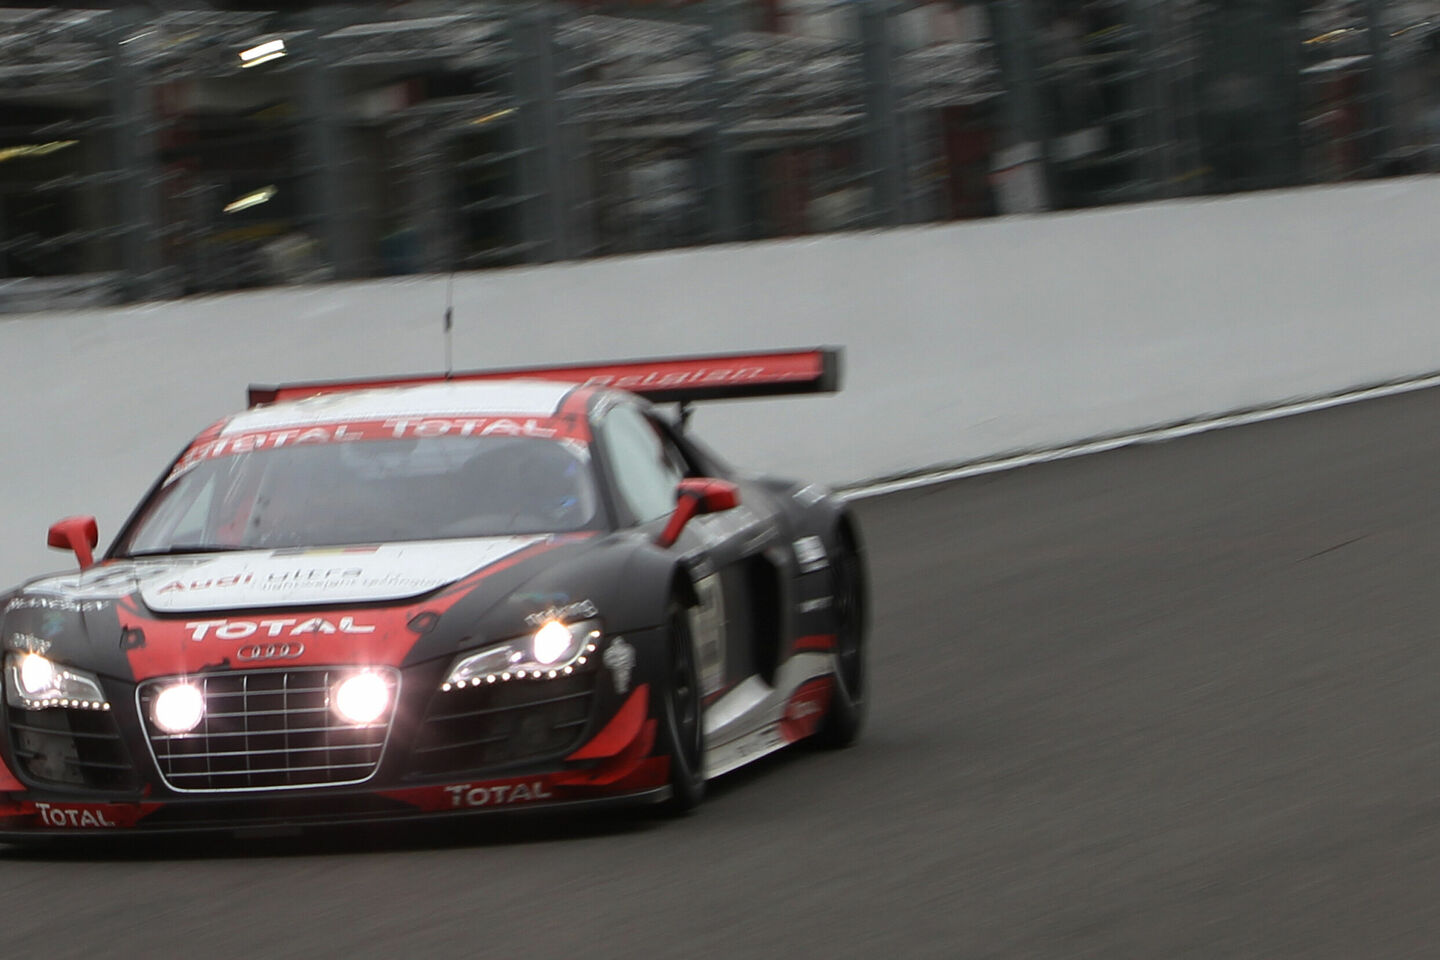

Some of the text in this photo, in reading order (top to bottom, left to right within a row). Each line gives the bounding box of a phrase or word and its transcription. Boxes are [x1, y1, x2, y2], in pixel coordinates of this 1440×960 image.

[382, 417, 559, 439] TOTAL
[156, 567, 363, 594] Audi ultra
[185, 616, 376, 642] TOTAL
[443, 781, 553, 807] TOTAL
[35, 801, 116, 827] TOTAL
